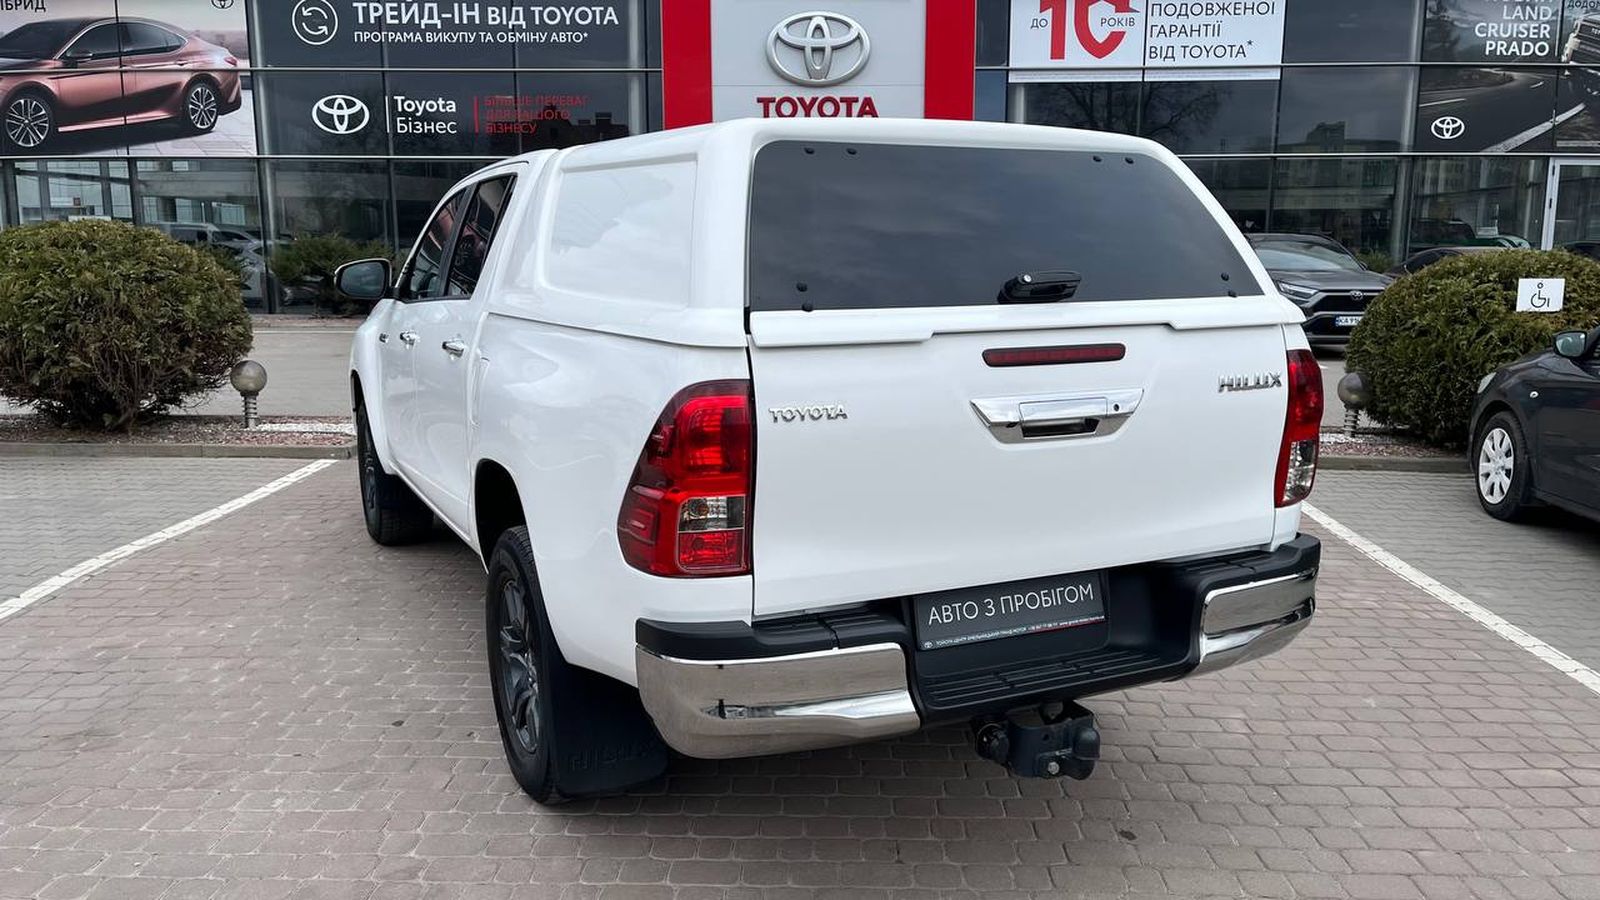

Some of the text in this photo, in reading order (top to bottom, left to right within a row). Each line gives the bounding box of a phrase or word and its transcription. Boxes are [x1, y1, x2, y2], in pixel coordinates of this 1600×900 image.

[352, 0, 619, 29] ТРЕЙД-ІН ВІД TOYOTA
[1502, 5, 1553, 21] LAND
[1030, 18, 1048, 29] ДО
[1100, 17, 1136, 27] РОКІВ
[1150, 20, 1223, 38] ГАРАНТІЇ
[1474, 22, 1551, 39] CRUISER
[354, 31, 423, 43] ПРОГРАМА
[425, 31, 476, 43] ВИКУПУ
[479, 31, 494, 43] ТА
[496, 31, 548, 43] ОБМІНУ
[1149, 45, 1176, 62] ВІД
[1484, 40, 1550, 57] PRADO
[393, 95, 457, 116] Toyota
[756, 96, 879, 118] TOYOTA
[396, 117, 457, 134] Бізнес
[1218, 373, 1282, 393] HILUX
[768, 404, 848, 423] TOYOTA
[928, 601, 978, 626] АВТО
[1000, 583, 1094, 614] ПРОБІГОМ
